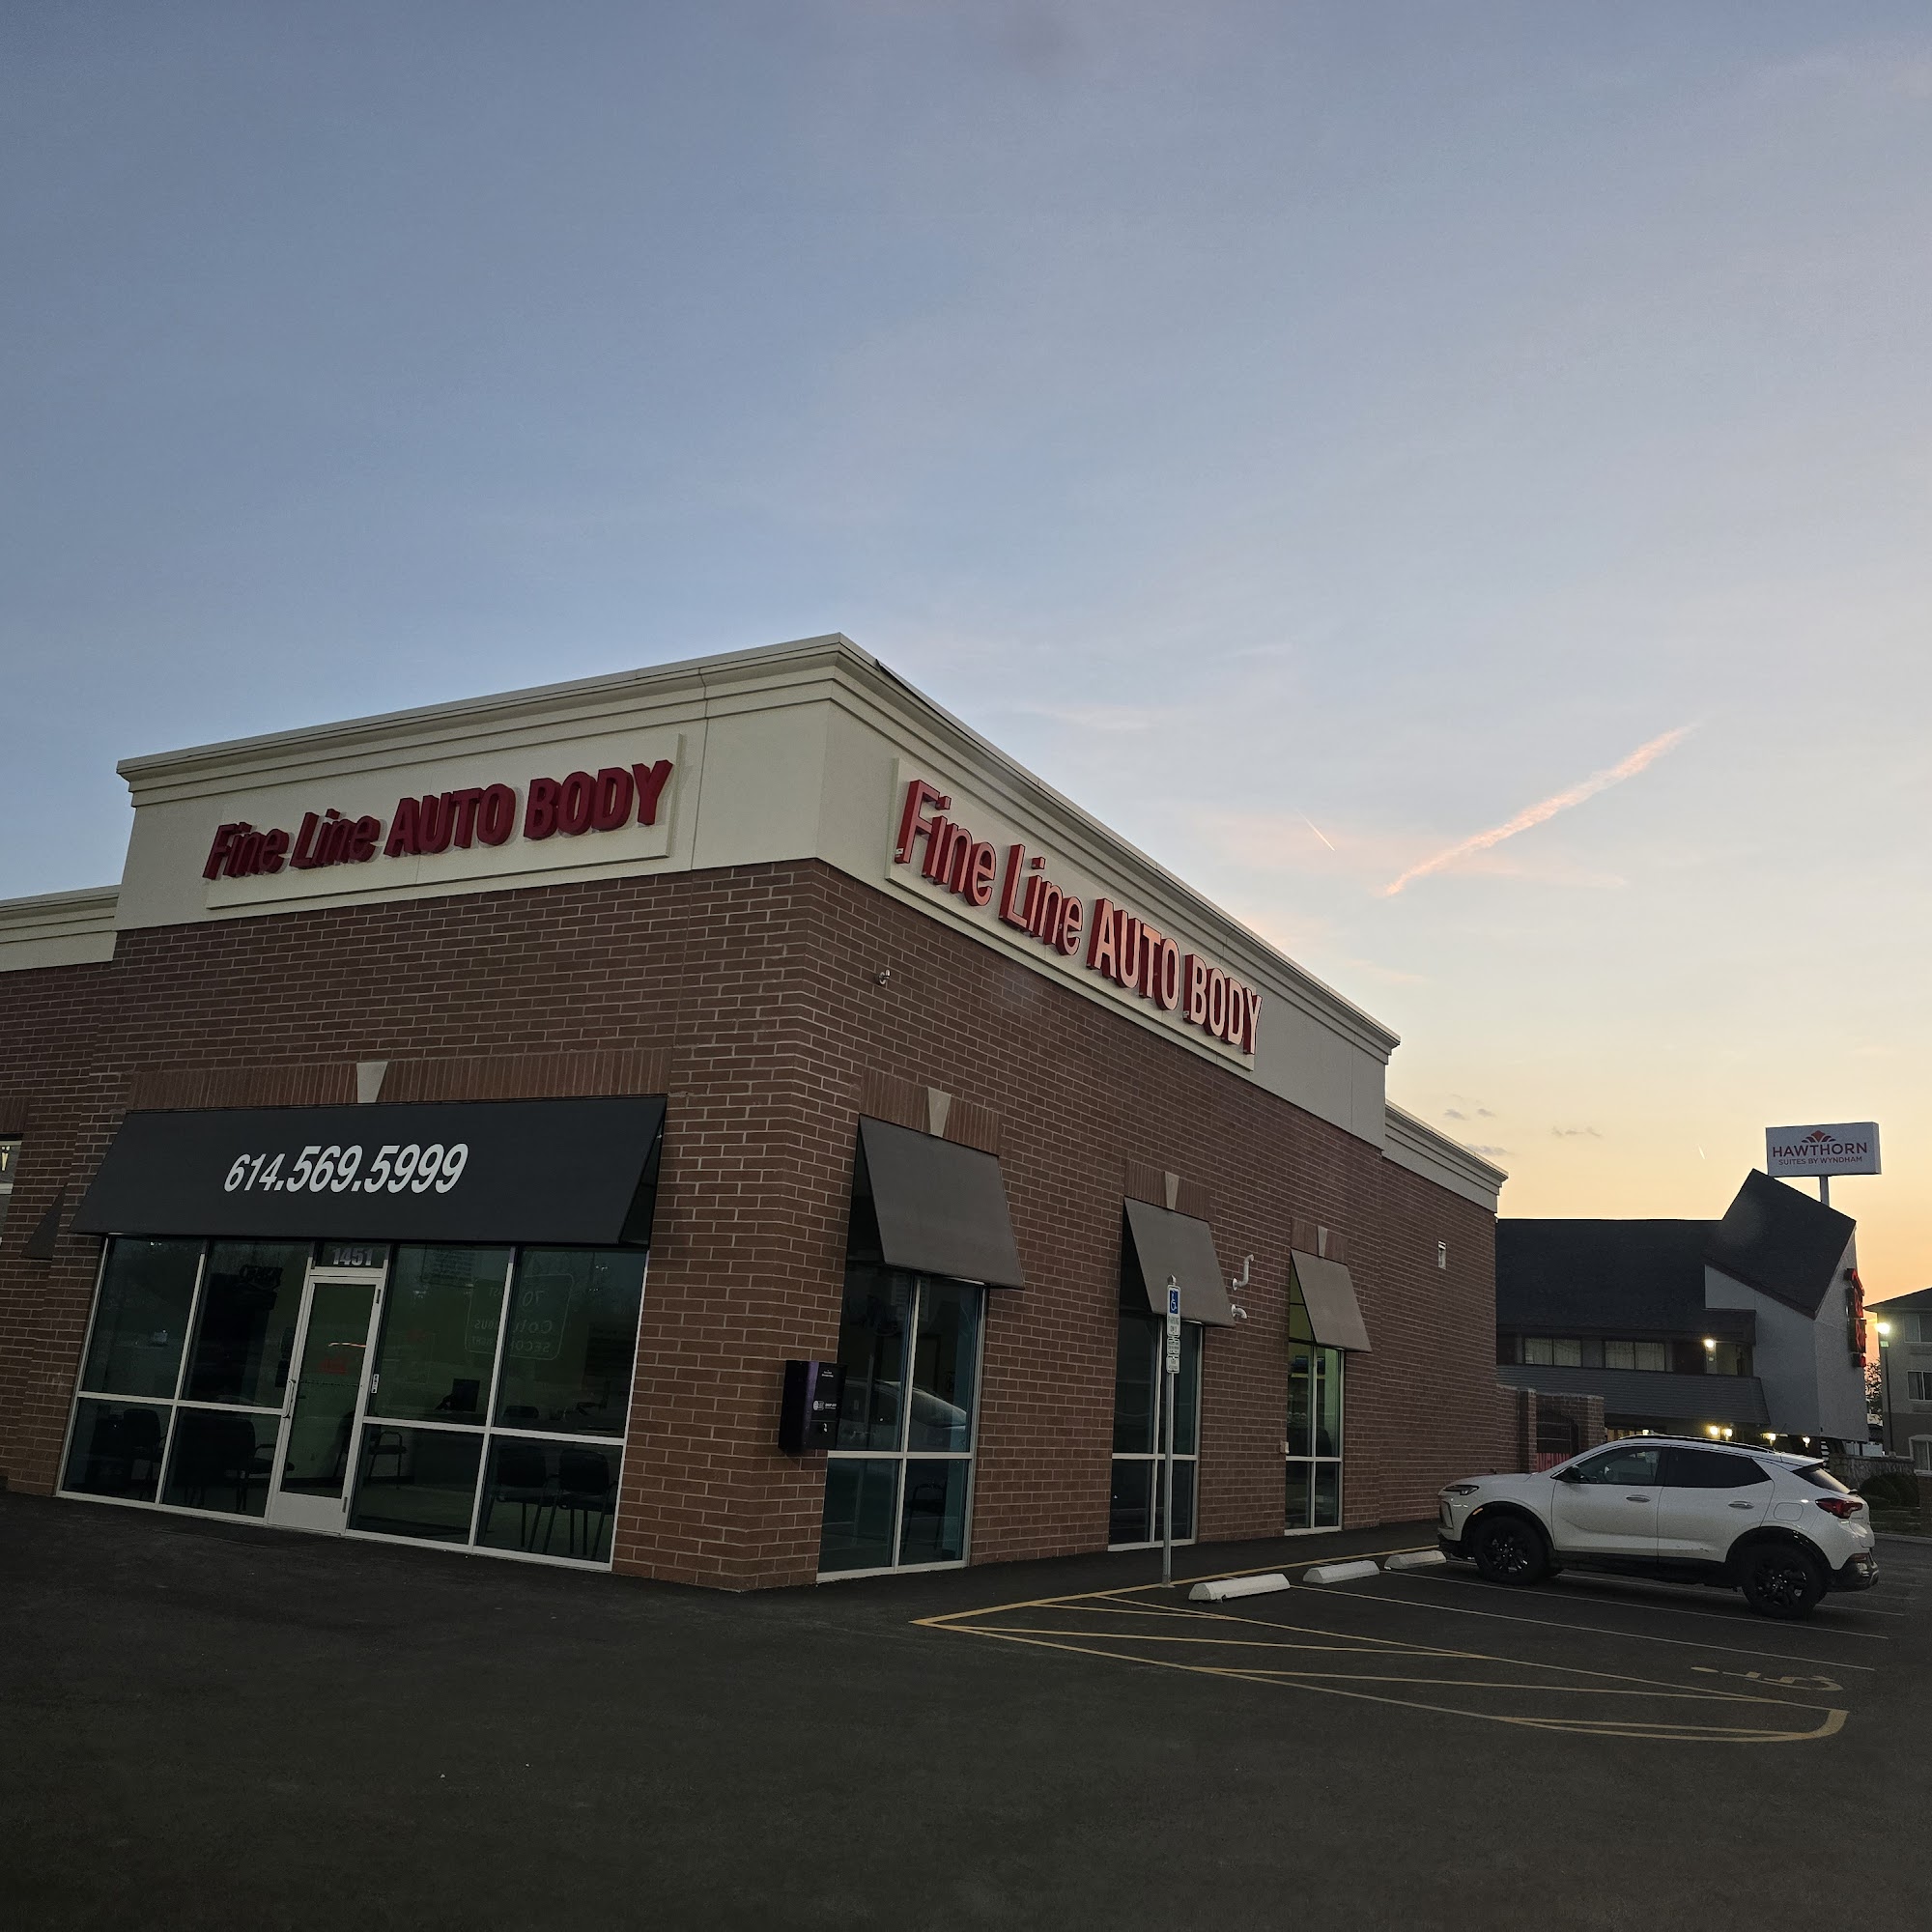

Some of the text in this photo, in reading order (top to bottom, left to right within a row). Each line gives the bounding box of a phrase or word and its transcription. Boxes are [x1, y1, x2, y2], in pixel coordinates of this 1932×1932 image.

[203, 759, 673, 880] Fine Line AUTO BODY
[895, 780, 1262, 1055] Fine Line AUTO BODY
[224, 1144, 469, 1193] 614.569.5999
[1773, 1142, 1867, 1157] HAWTHORN
[333, 1248, 373, 1265] 1451
